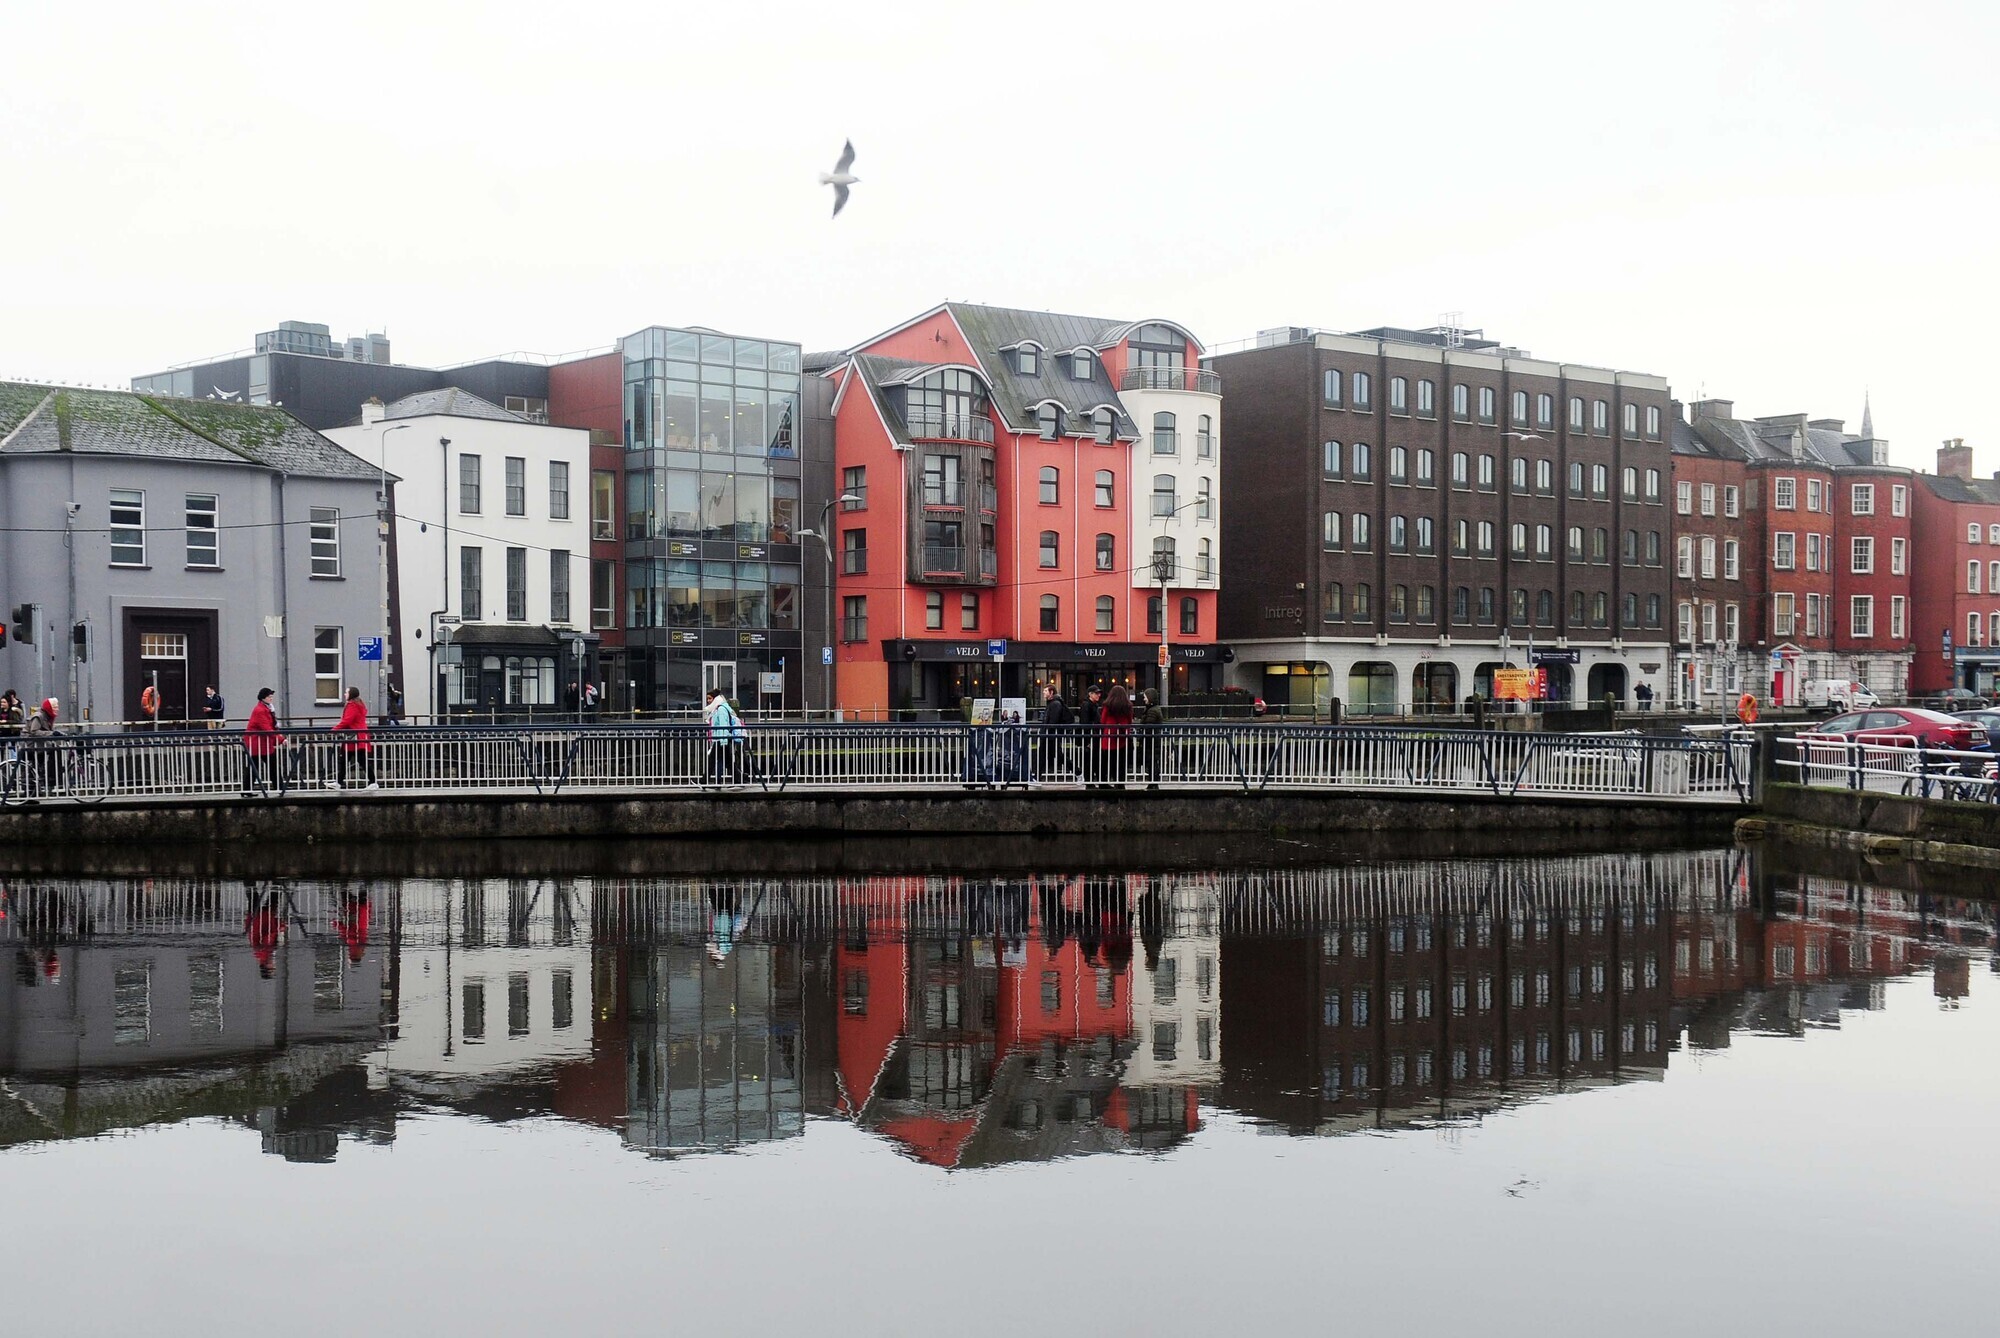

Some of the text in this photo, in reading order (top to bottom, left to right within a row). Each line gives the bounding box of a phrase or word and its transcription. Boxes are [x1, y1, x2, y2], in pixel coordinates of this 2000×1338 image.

[1264, 606, 1302, 619] Intreo
[956, 647, 980, 656] VELO
[1084, 648, 1106, 657] VELO
[1184, 649, 1205, 657] VELO
